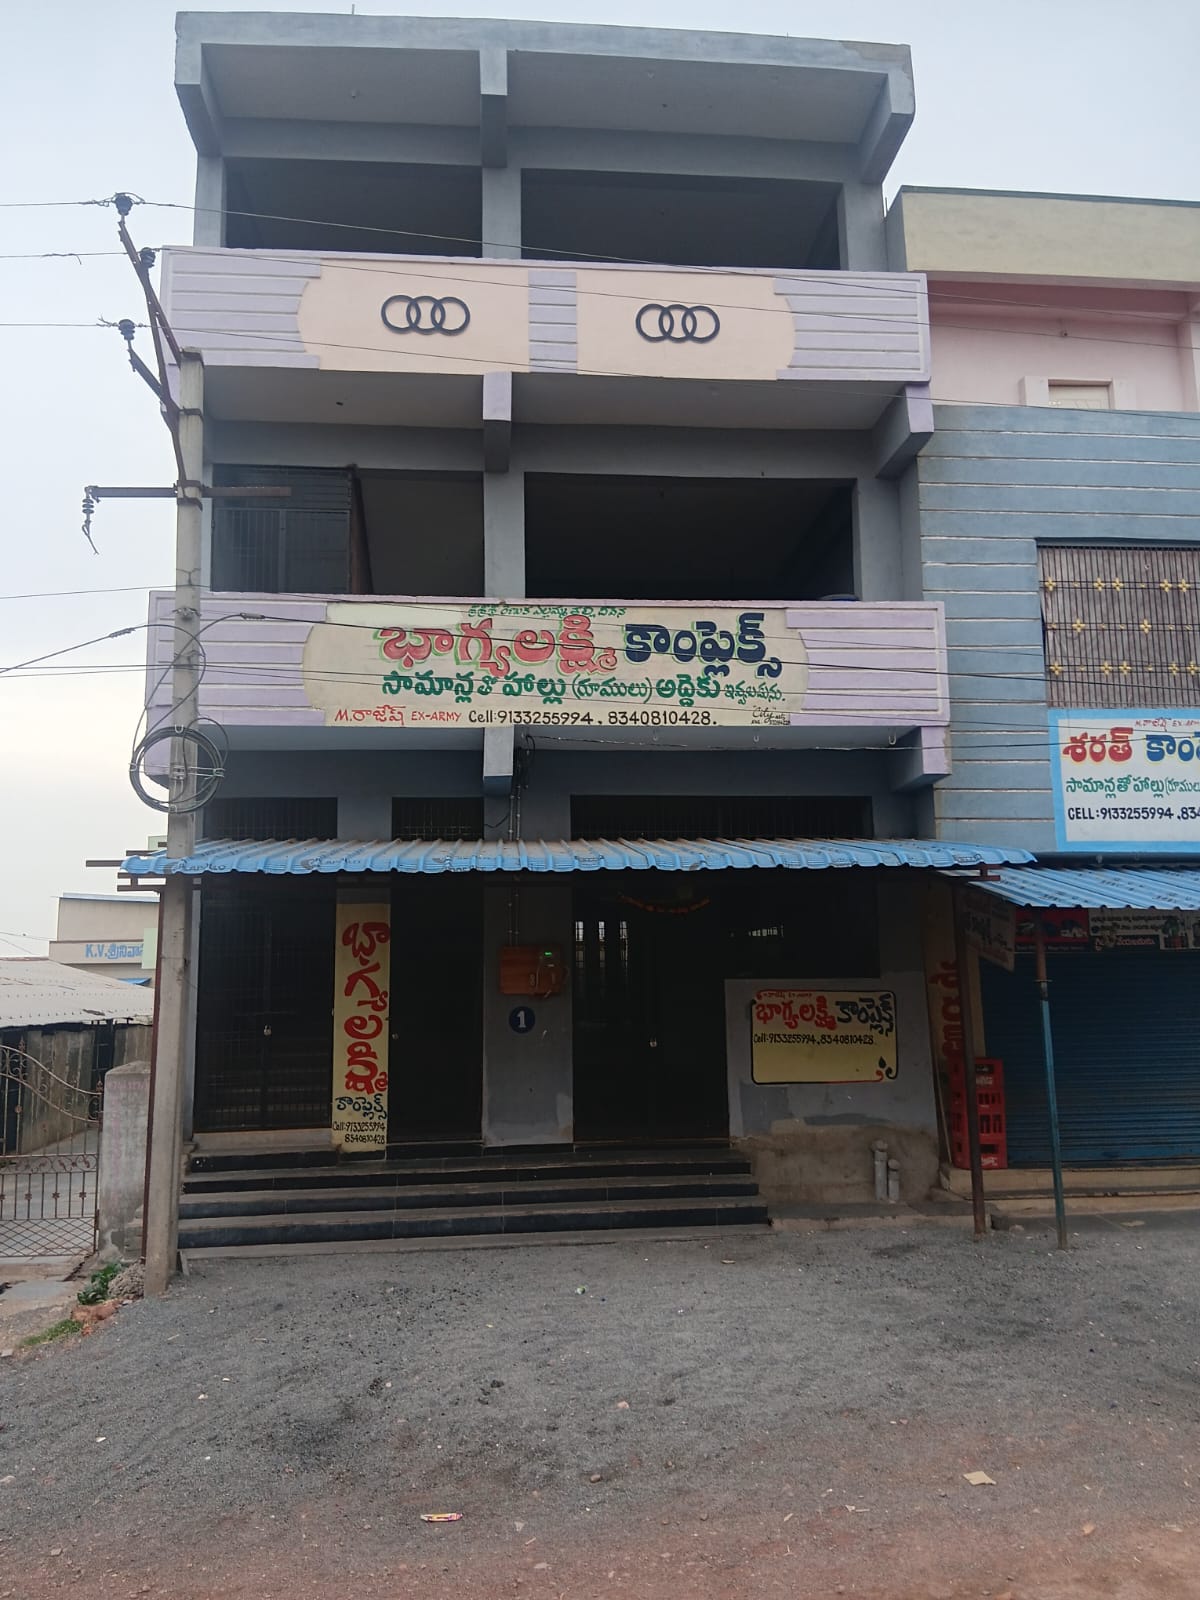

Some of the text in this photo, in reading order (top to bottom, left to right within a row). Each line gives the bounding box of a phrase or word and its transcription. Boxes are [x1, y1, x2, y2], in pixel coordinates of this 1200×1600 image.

[624, 612, 782, 677] కాంప్లెక్స్
[411, 710, 462, 721] EX-ARMY
[1062, 726, 1200, 763] శరత్ కాం
[514, 1009, 527, 1028] 1
[335, 1093, 388, 1120] కాంప్లెక్స్
